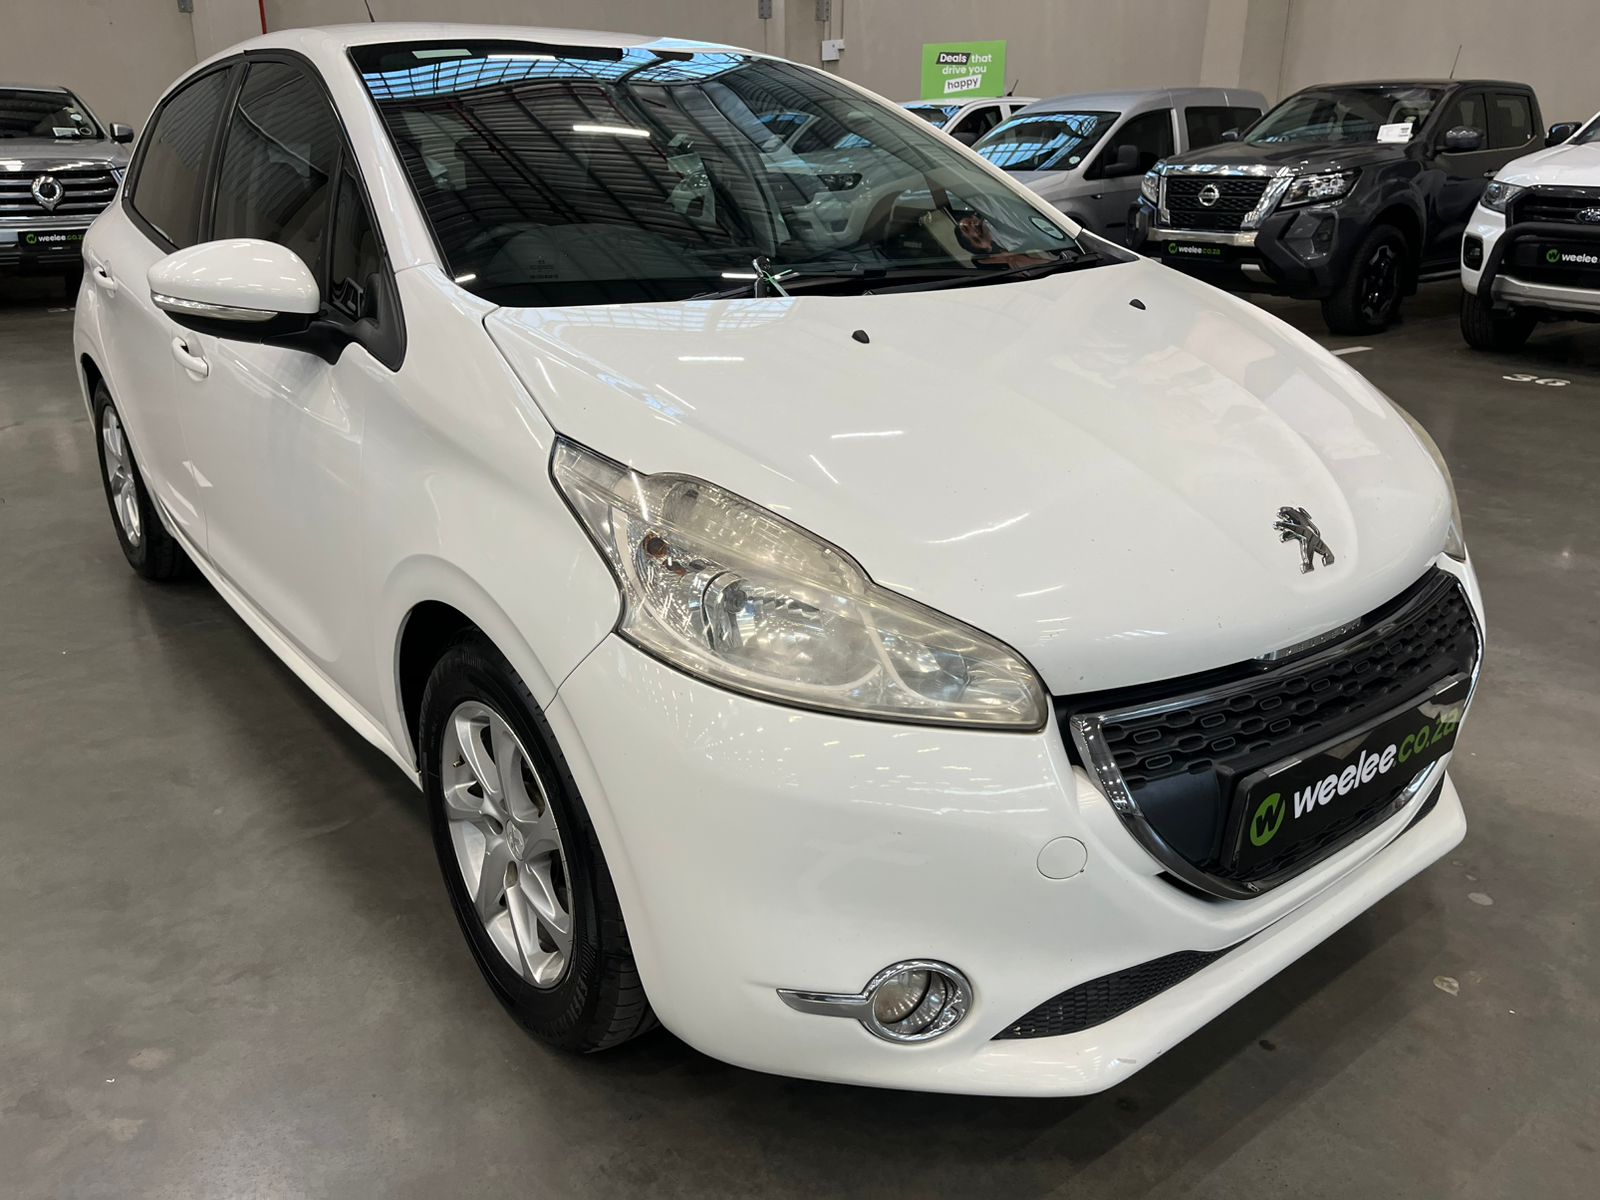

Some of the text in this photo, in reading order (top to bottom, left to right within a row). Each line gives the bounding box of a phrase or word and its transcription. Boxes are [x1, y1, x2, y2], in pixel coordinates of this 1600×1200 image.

[939, 53, 993, 63] Deals that
[942, 65, 987, 76] drive you
[947, 78, 979, 90] happy
[1294, 708, 1459, 819] weelee.co.za
